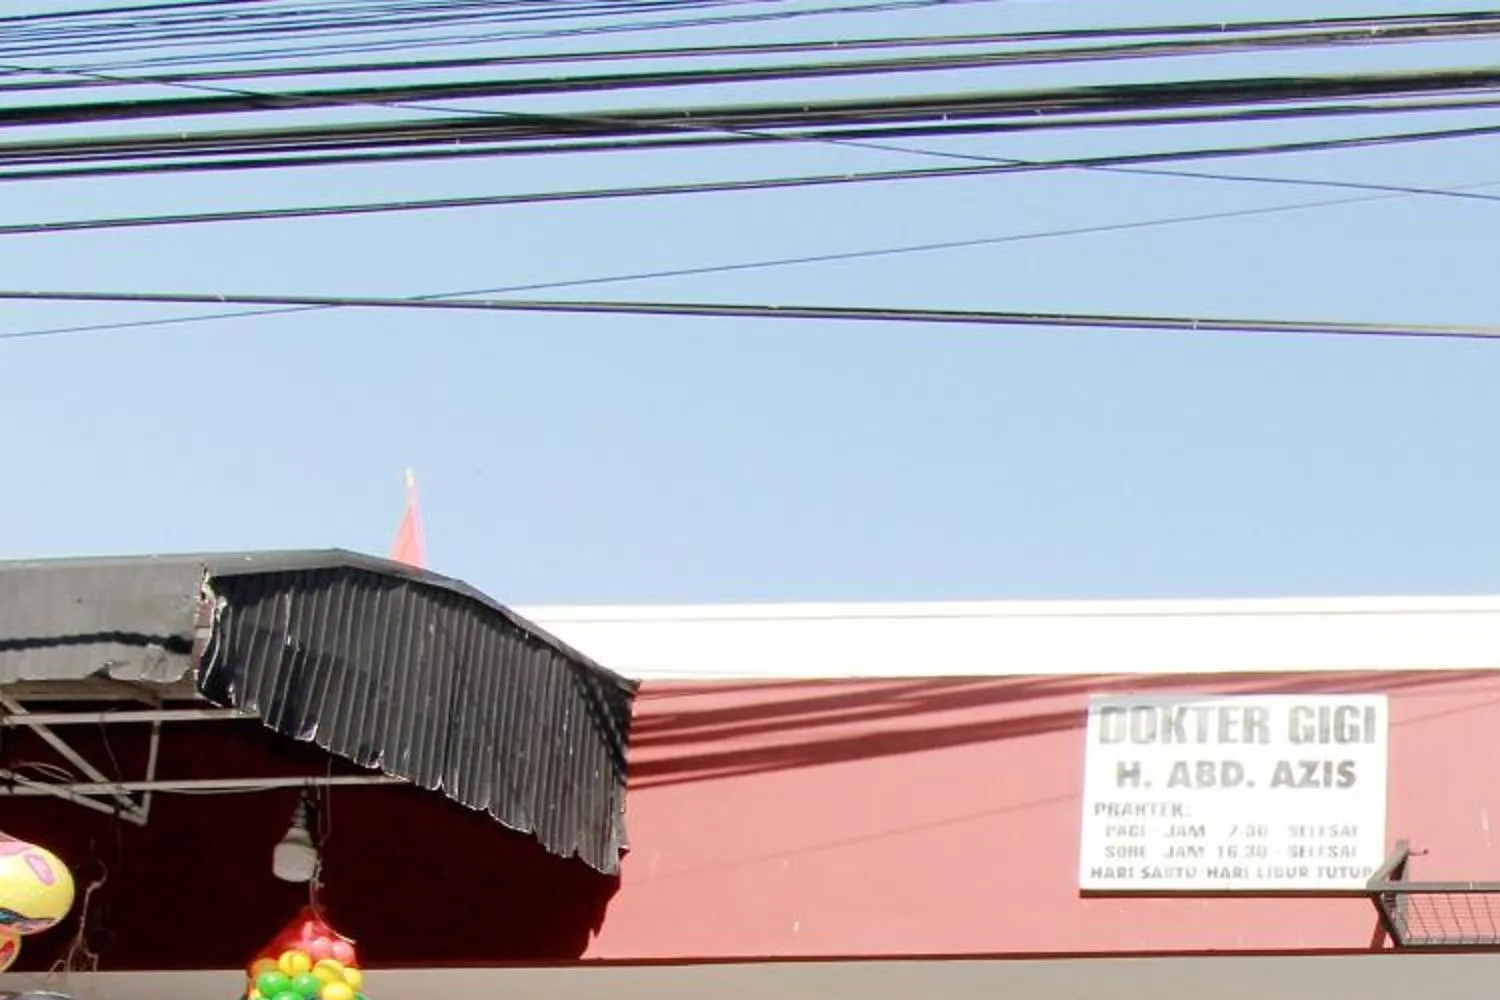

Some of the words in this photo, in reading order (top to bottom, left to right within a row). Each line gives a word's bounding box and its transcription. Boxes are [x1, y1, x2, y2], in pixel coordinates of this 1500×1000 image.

[1098, 705, 1271, 745] DOKTER
[1288, 704, 1377, 745] GIGI
[1116, 760, 1152, 788] H.
[1167, 760, 1256, 788] ABD.
[1270, 760, 1358, 788] AZIS
[1163, 824, 1206, 838] JAM
[1163, 844, 1206, 859] JAM
[1090, 866, 1135, 879] HARI
[1207, 866, 1249, 879] HARI
[1257, 866, 1309, 879] LIBUR
[1317, 866, 1373, 879] TUTUP
